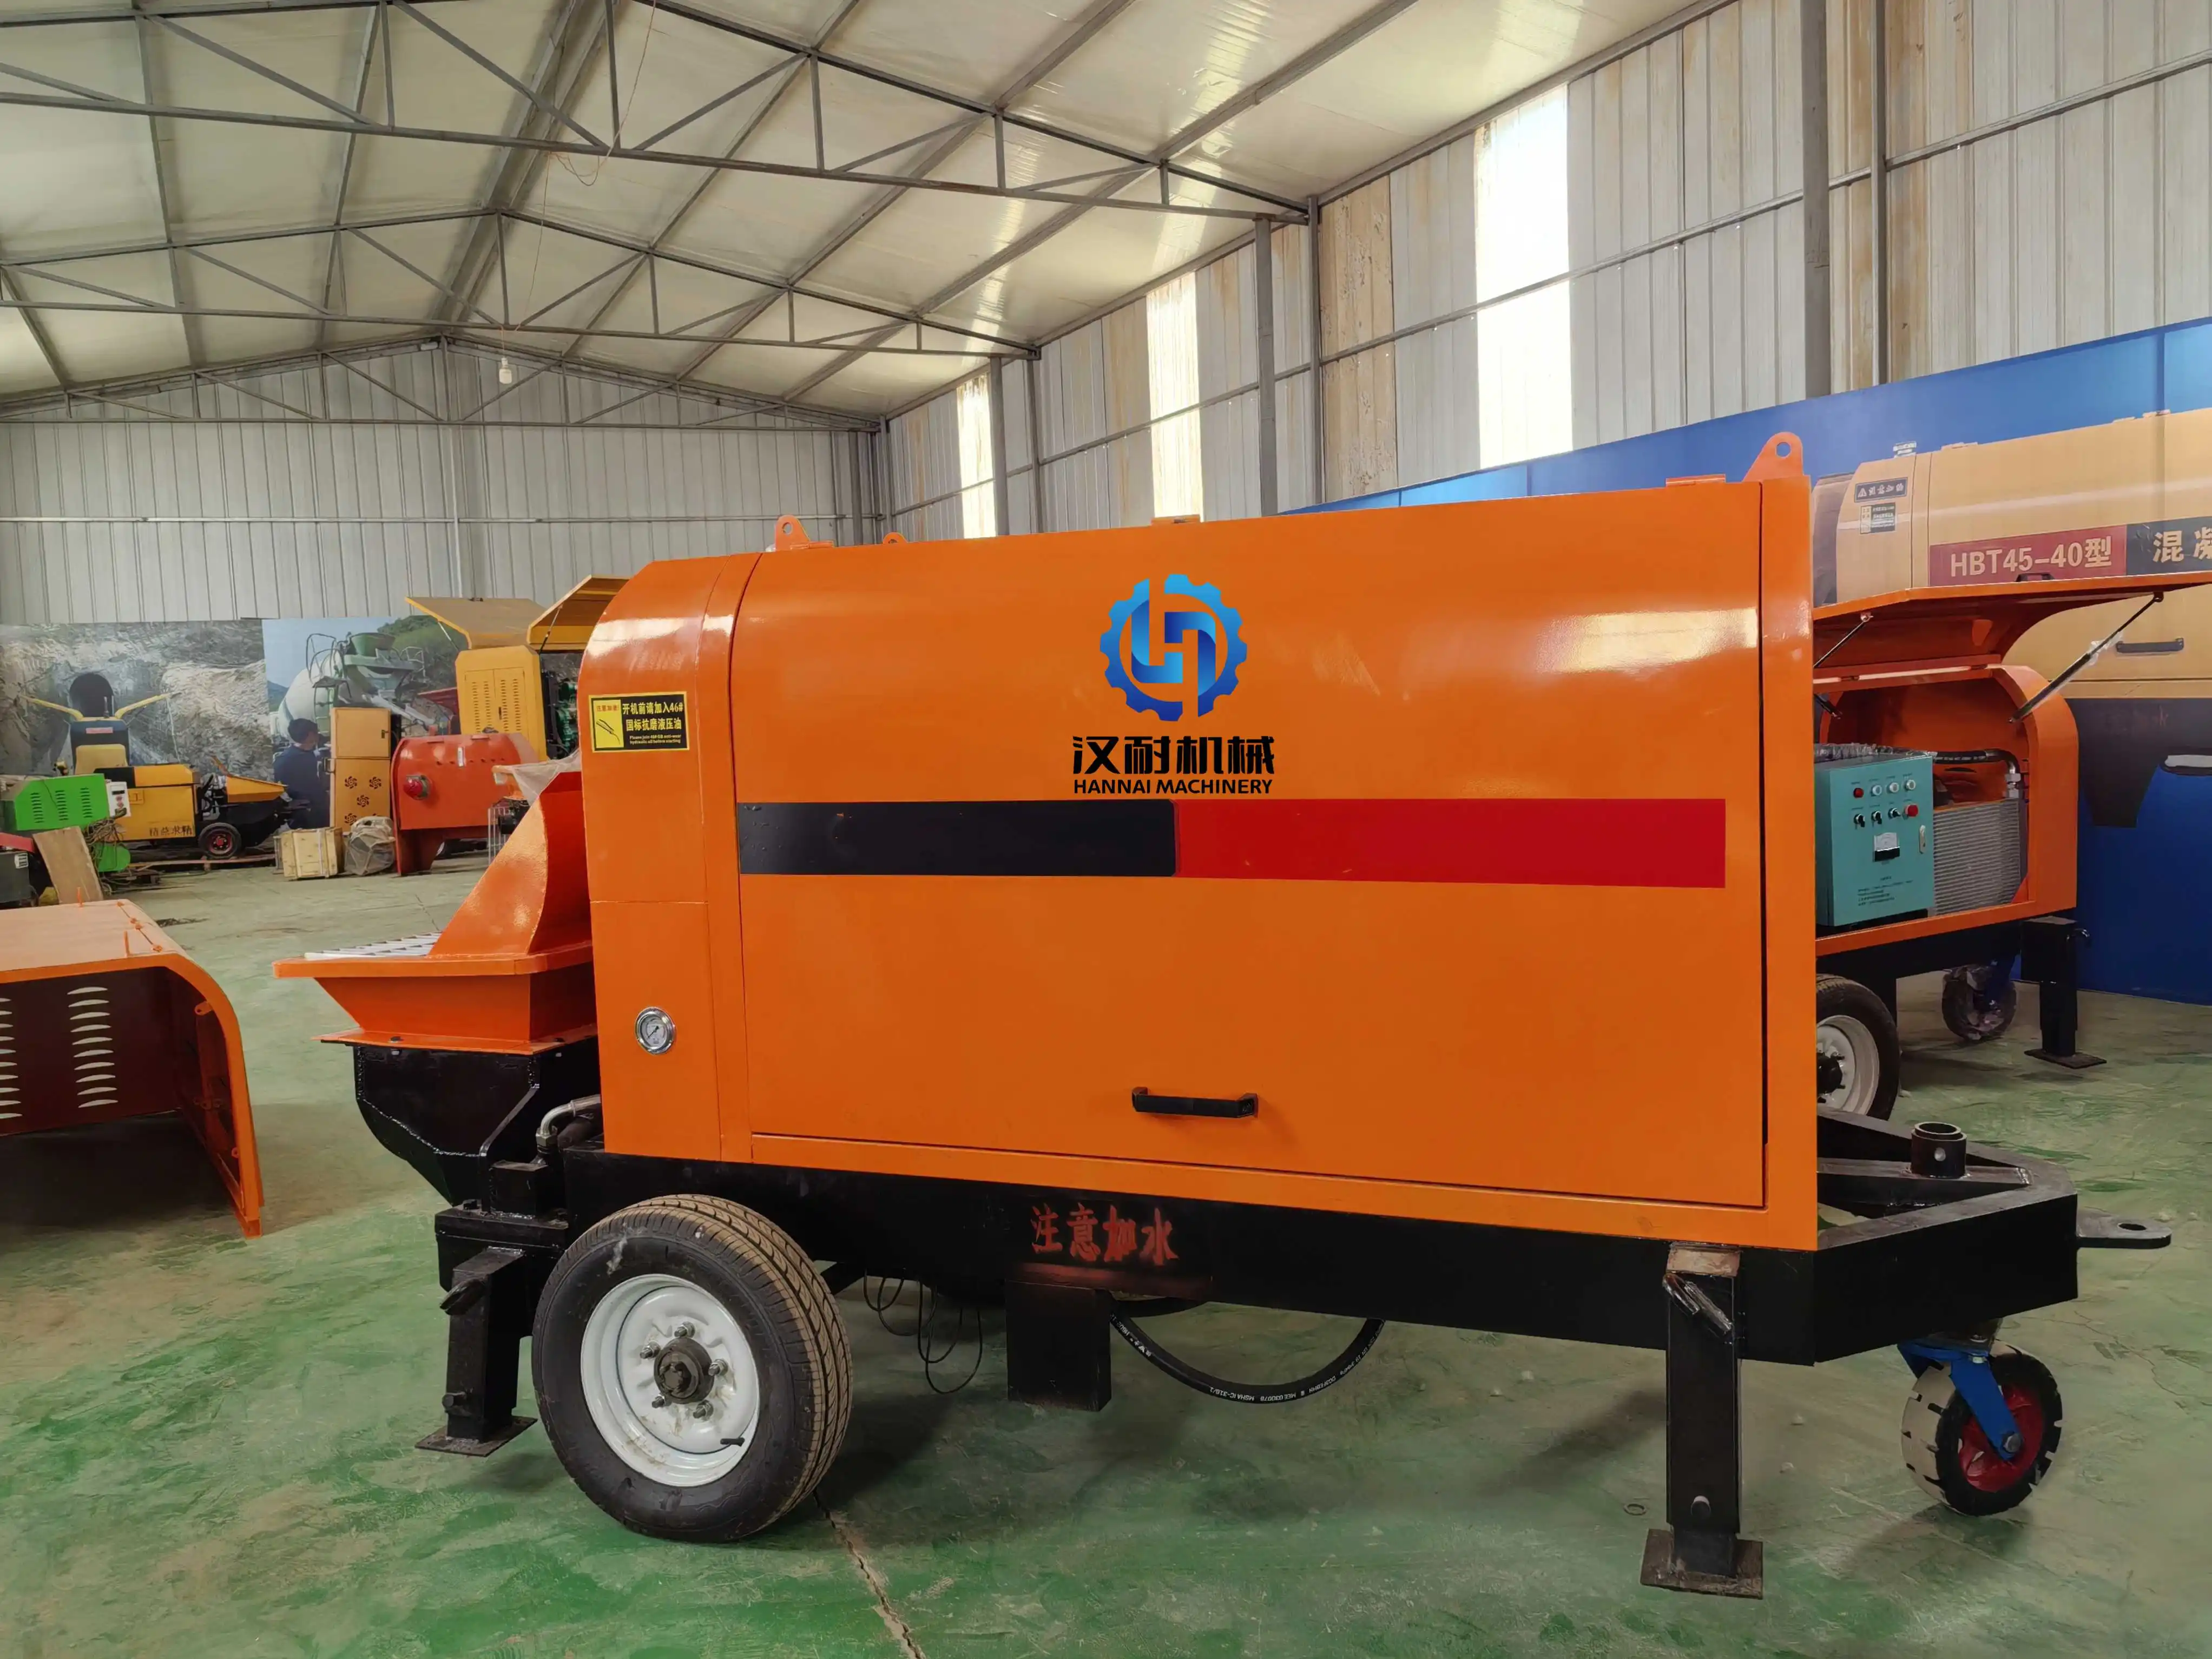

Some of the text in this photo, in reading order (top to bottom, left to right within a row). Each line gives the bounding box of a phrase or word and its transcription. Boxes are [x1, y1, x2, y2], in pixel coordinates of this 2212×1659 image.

[1951, 536, 2112, 577] HBT45-40型
[623, 702, 683, 715] 开机前请加入46#
[626, 718, 682, 732] 国标抗磨液压油
[1031, 1202, 1180, 1266] 注意加水
